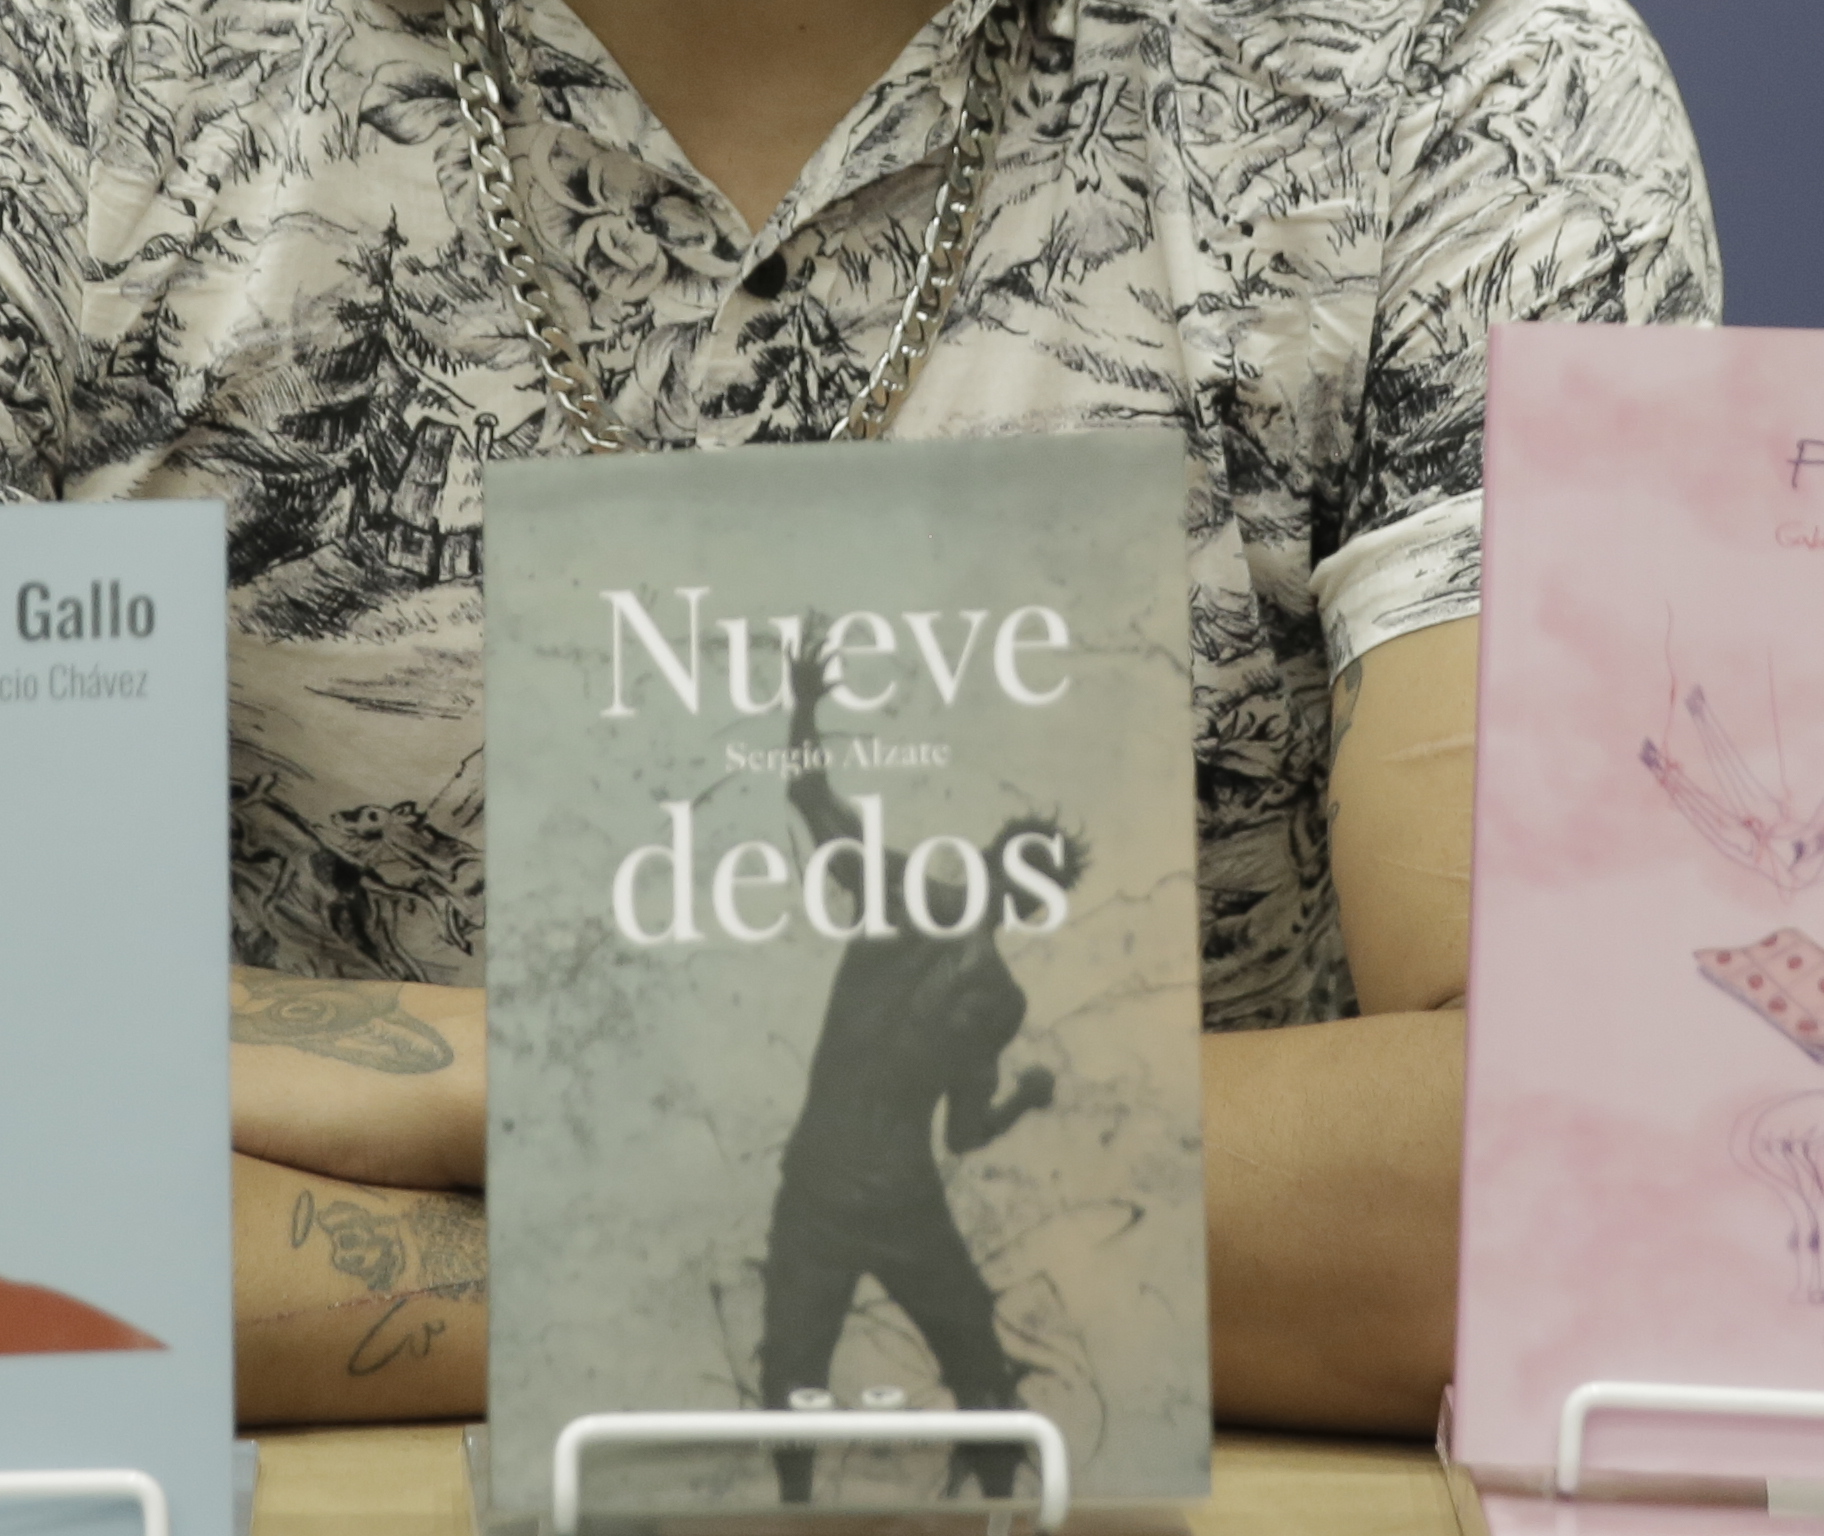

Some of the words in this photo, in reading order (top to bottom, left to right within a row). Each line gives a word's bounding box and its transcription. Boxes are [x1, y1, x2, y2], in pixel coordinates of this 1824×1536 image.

[16, 577, 156, 643] Gallo
[48, 662, 149, 702] Chávez
[599, 585, 1071, 720] Nueve
[724, 739, 832, 778] Sergio
[843, 737, 952, 769] Alzate
[611, 792, 1071, 945] dedos
